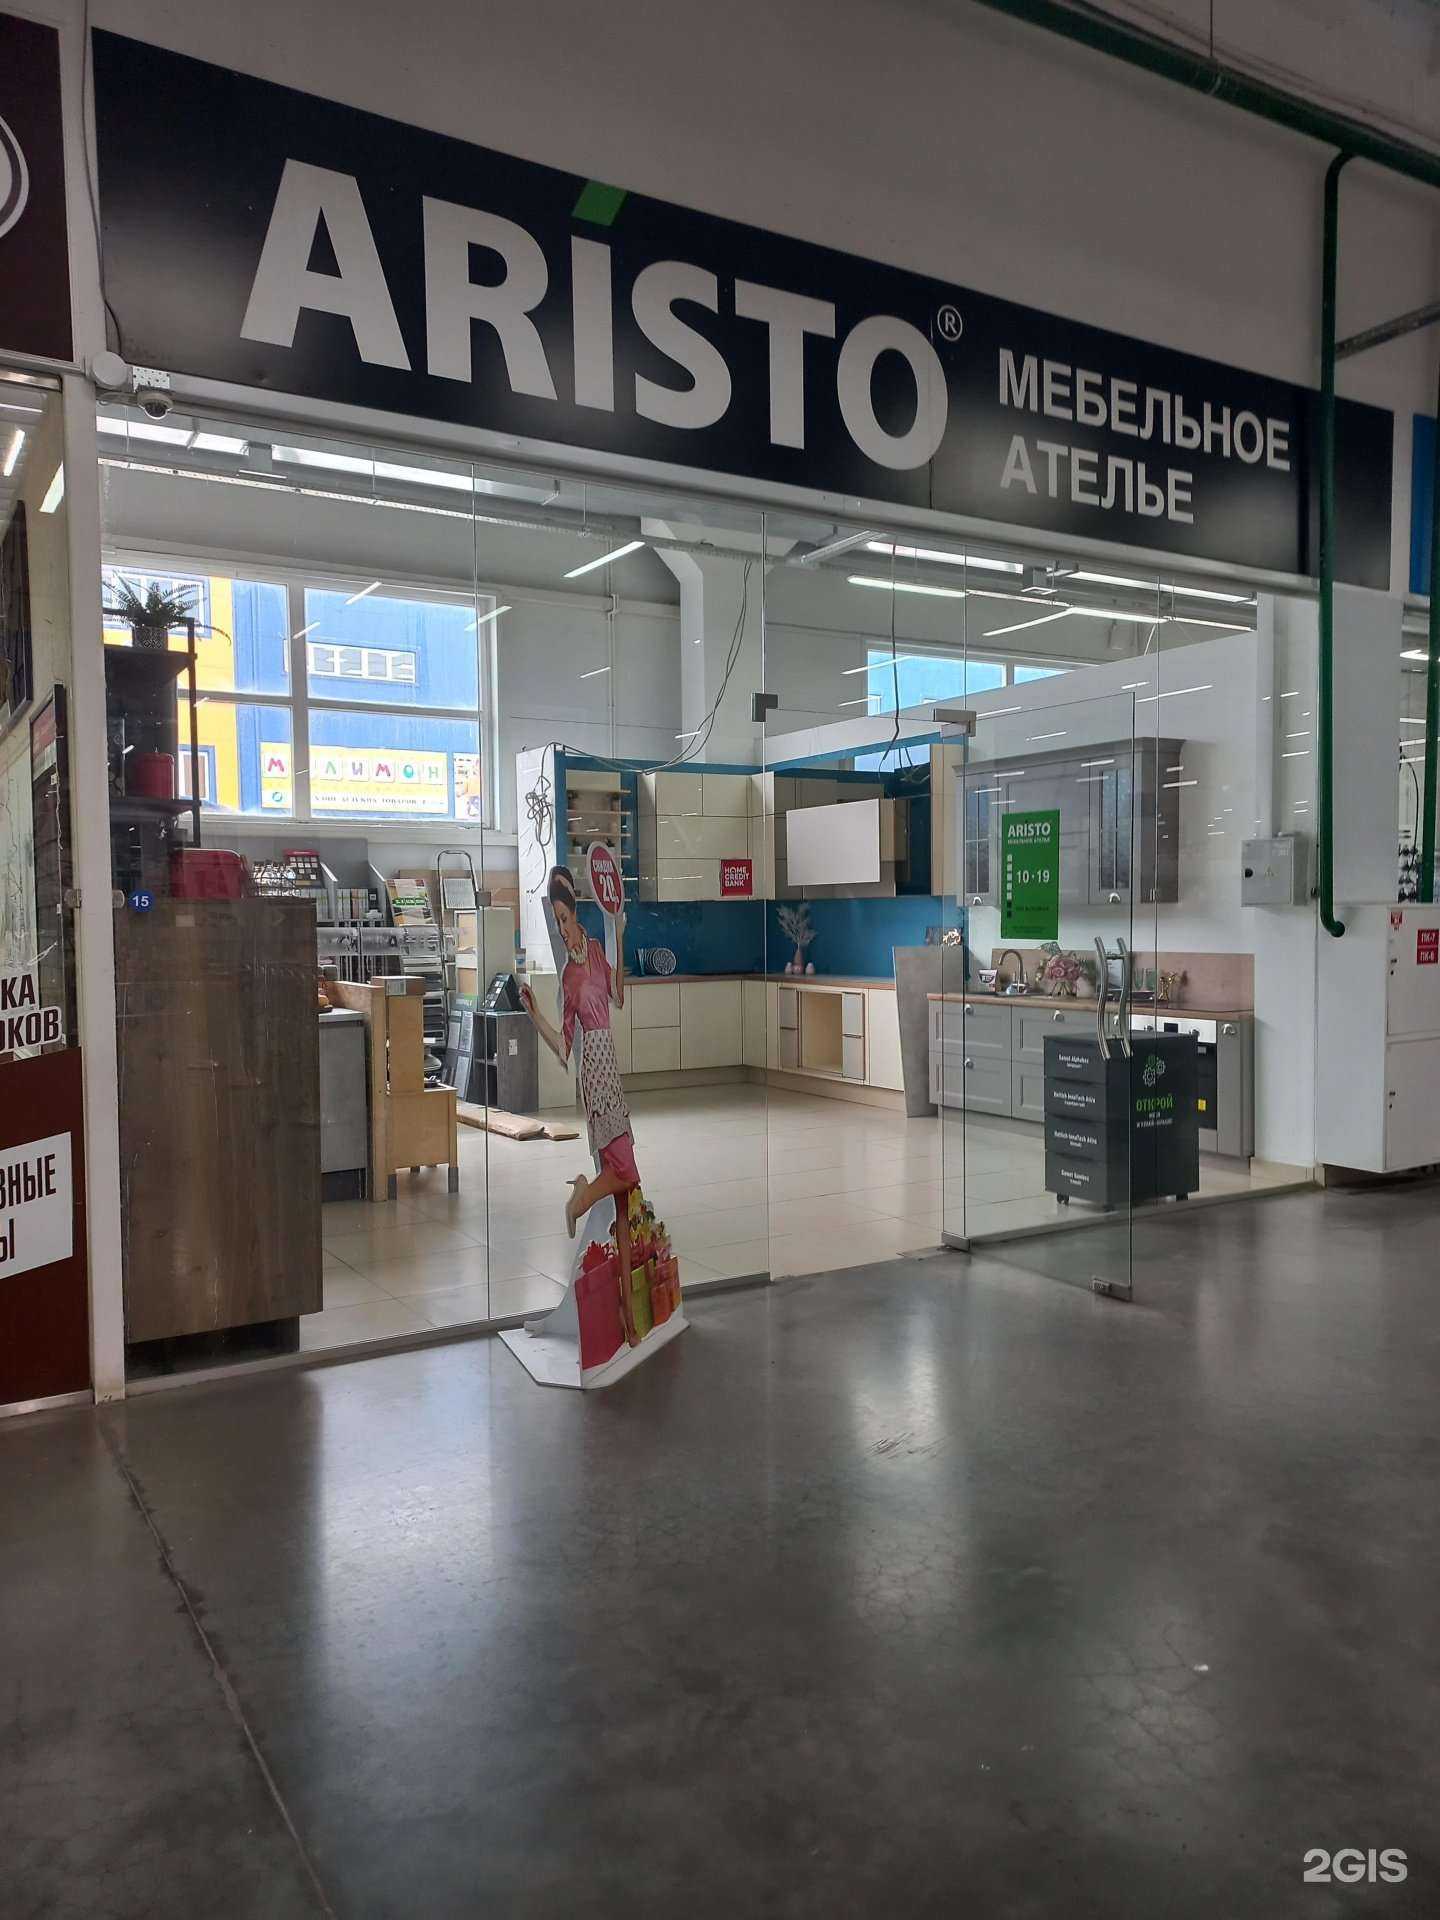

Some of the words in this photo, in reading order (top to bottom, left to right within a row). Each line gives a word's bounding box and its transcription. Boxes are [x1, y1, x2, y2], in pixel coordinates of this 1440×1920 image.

[240, 159, 949, 471] ARISTO
[998, 347, 1291, 472] МЕБЕЛЬНОЕ
[999, 434, 1194, 525] АТЕЛЬЕ
[267, 757, 440, 779] МЛИМОН
[1008, 821, 1051, 838] ARISTO
[724, 866, 747, 874] HOME
[132, 895, 149, 907] 15
